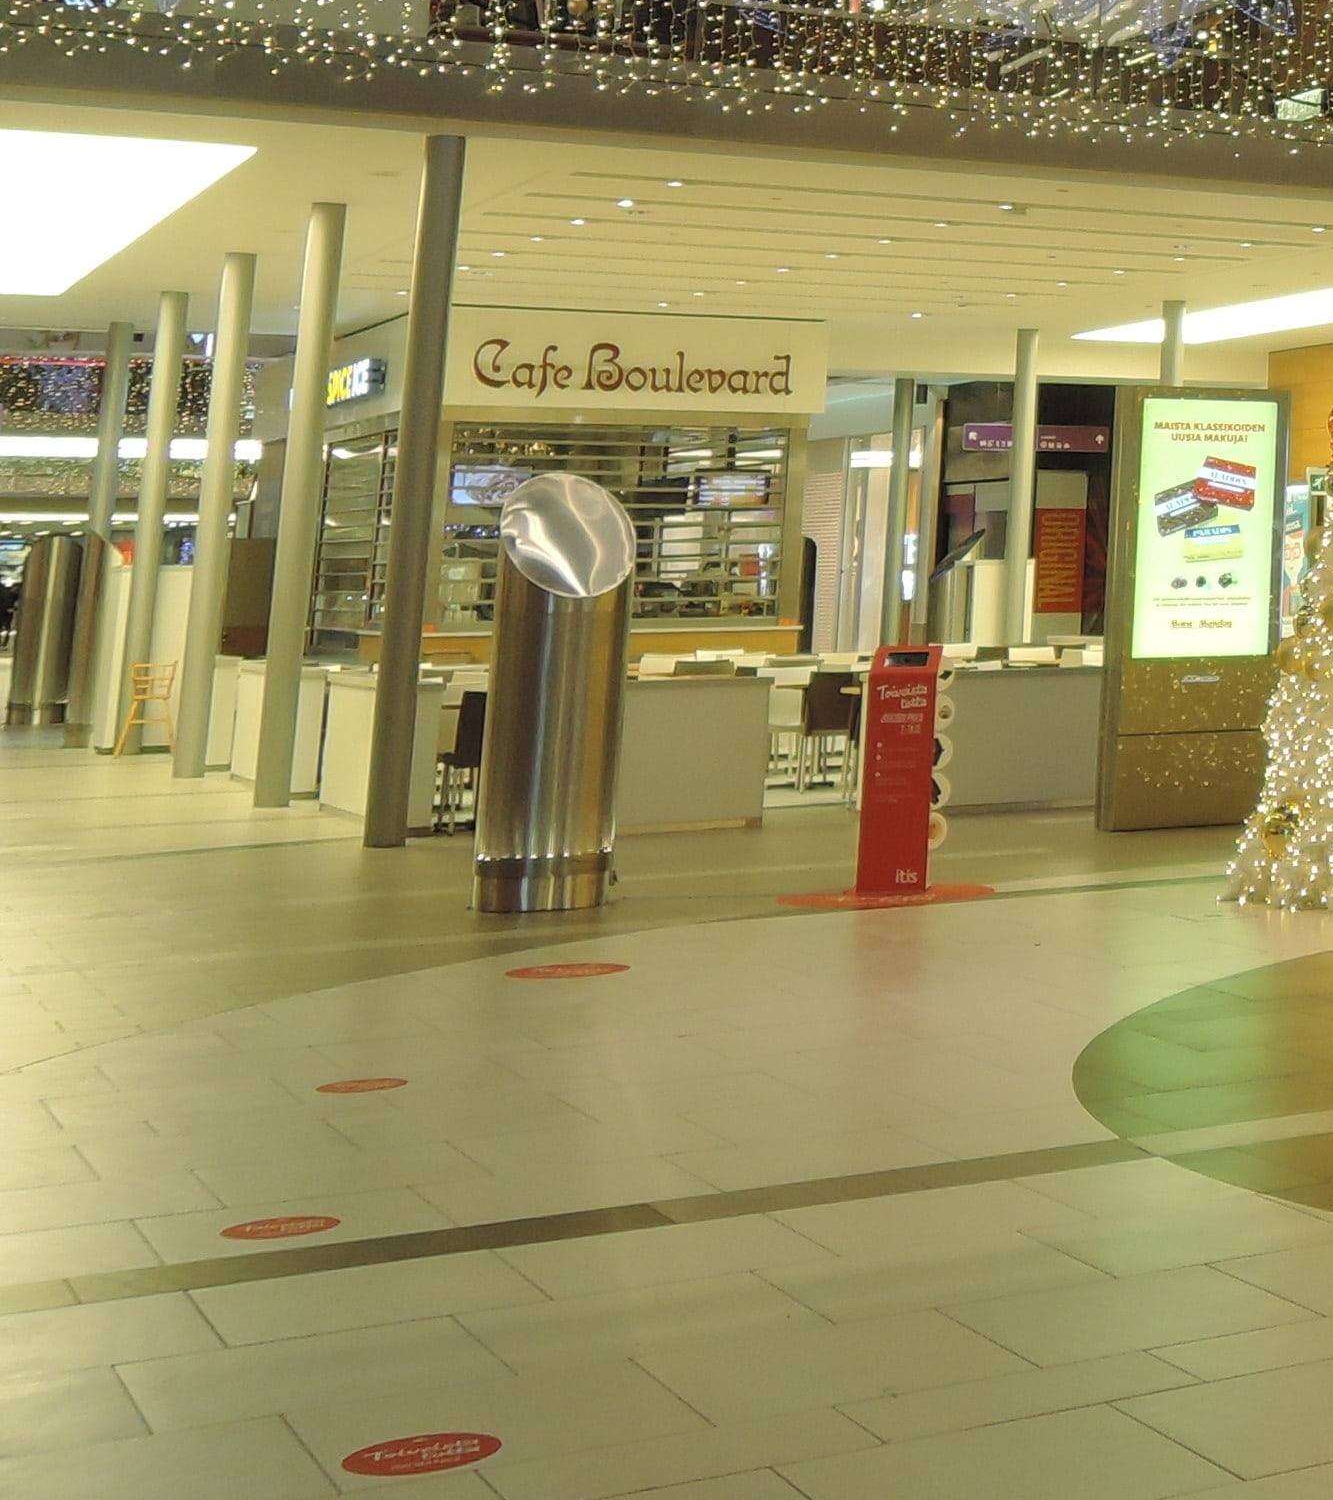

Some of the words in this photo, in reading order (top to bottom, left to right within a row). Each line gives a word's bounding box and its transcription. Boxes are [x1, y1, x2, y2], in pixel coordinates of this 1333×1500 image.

[472, 338, 573, 398] Cafe
[580, 342, 792, 396] Boulevard
[1154, 421, 1191, 431] MAISTA
[1193, 422, 1266, 433] KLASSIKOIDEN
[1171, 432, 1202, 442] UUSIA
[1204, 433, 1248, 444] MAKUJA!
[1039, 513, 1080, 609] ORIGINAL
[895, 868, 919, 884] itis
